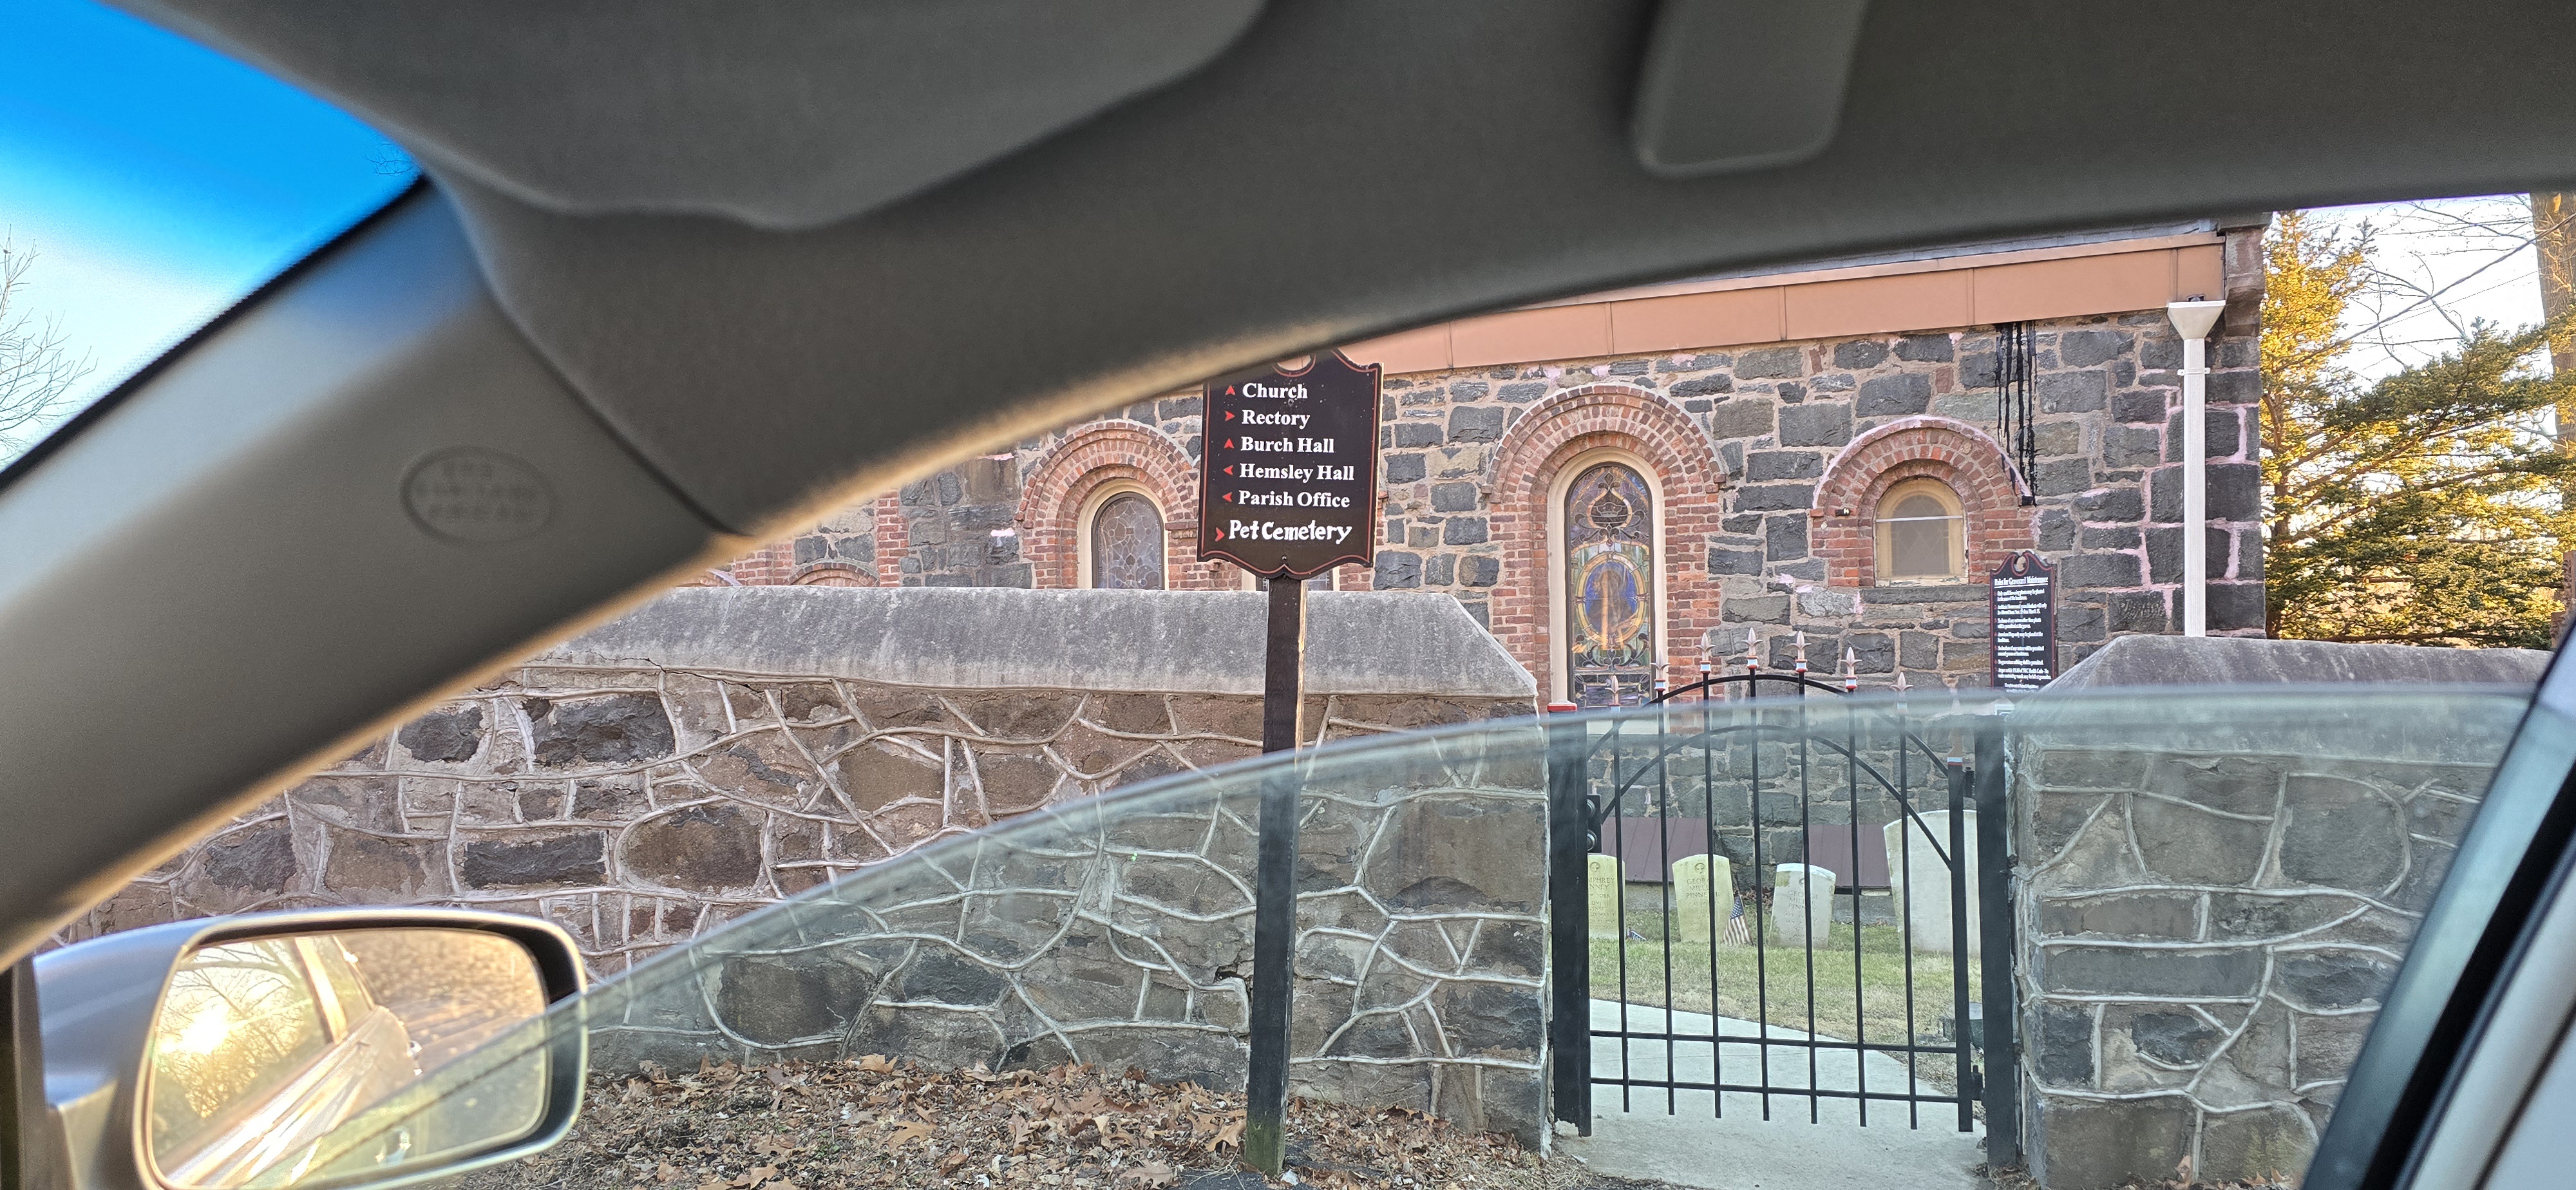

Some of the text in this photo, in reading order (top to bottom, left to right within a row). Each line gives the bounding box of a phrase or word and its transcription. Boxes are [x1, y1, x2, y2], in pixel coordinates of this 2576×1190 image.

[1242, 382, 1308, 401] Church
[1241, 410, 1311, 430] Rectory
[1240, 436, 1334, 453] Burch Hall
[1239, 462, 1355, 484] Hemsley Hall
[1238, 489, 1350, 508] Parish Office
[1228, 518, 1353, 545] Pet Cemetery
[1787, 890, 1819, 900] GEOGE
